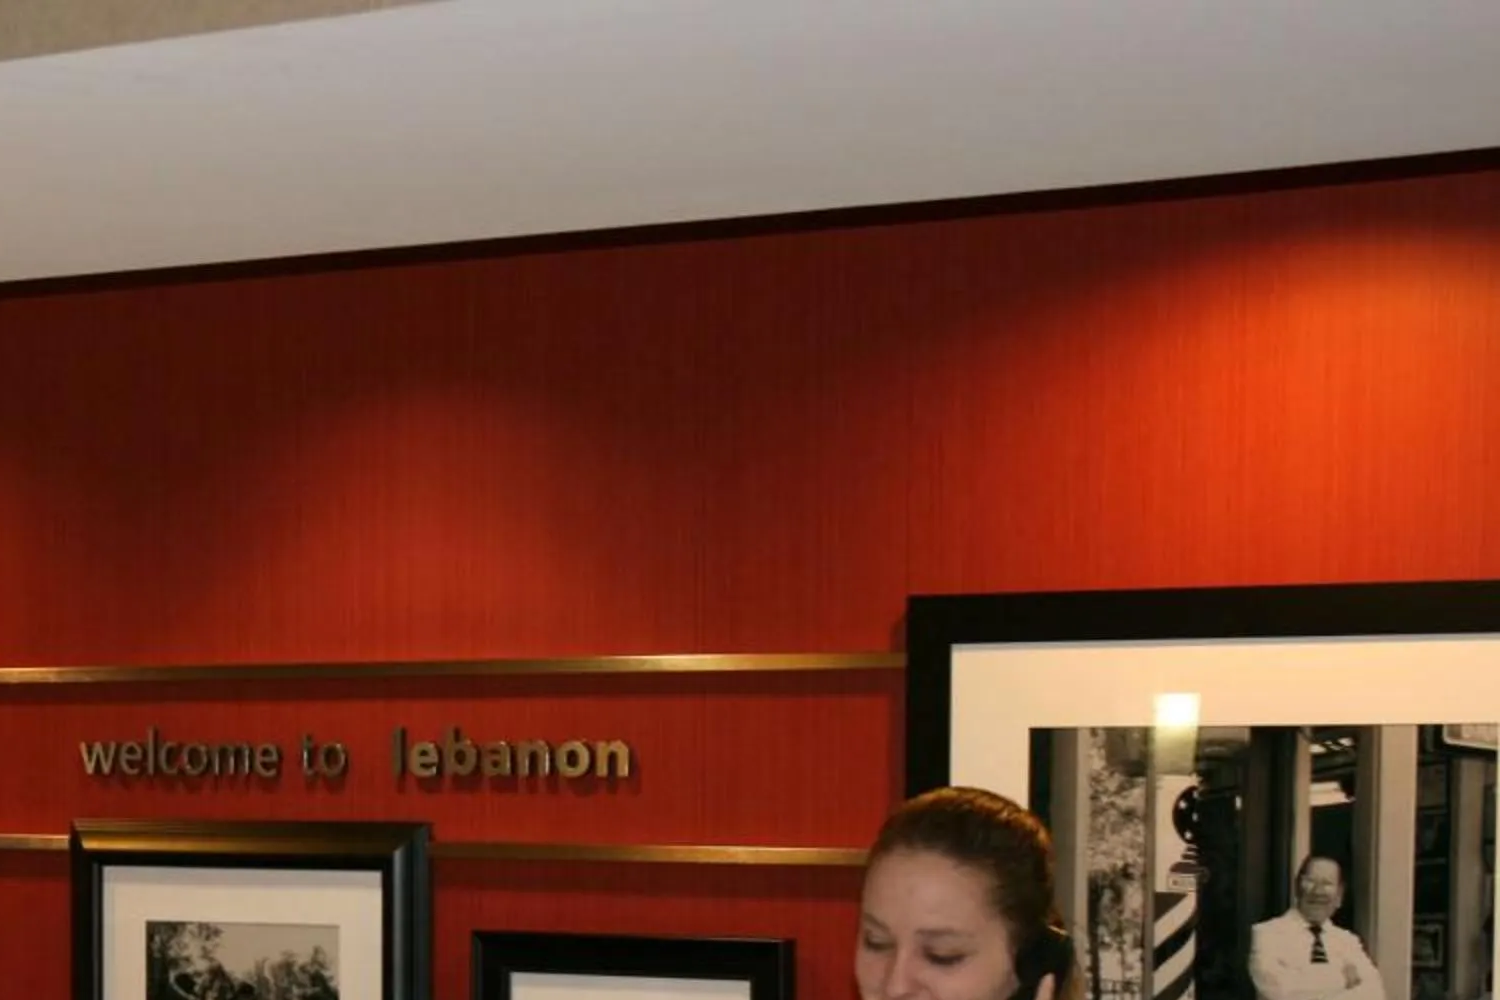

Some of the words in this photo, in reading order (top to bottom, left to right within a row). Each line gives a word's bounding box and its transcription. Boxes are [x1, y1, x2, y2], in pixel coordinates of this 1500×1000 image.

[79, 726, 281, 780] welcome
[301, 733, 348, 780] to
[391, 726, 632, 780] lebanon
